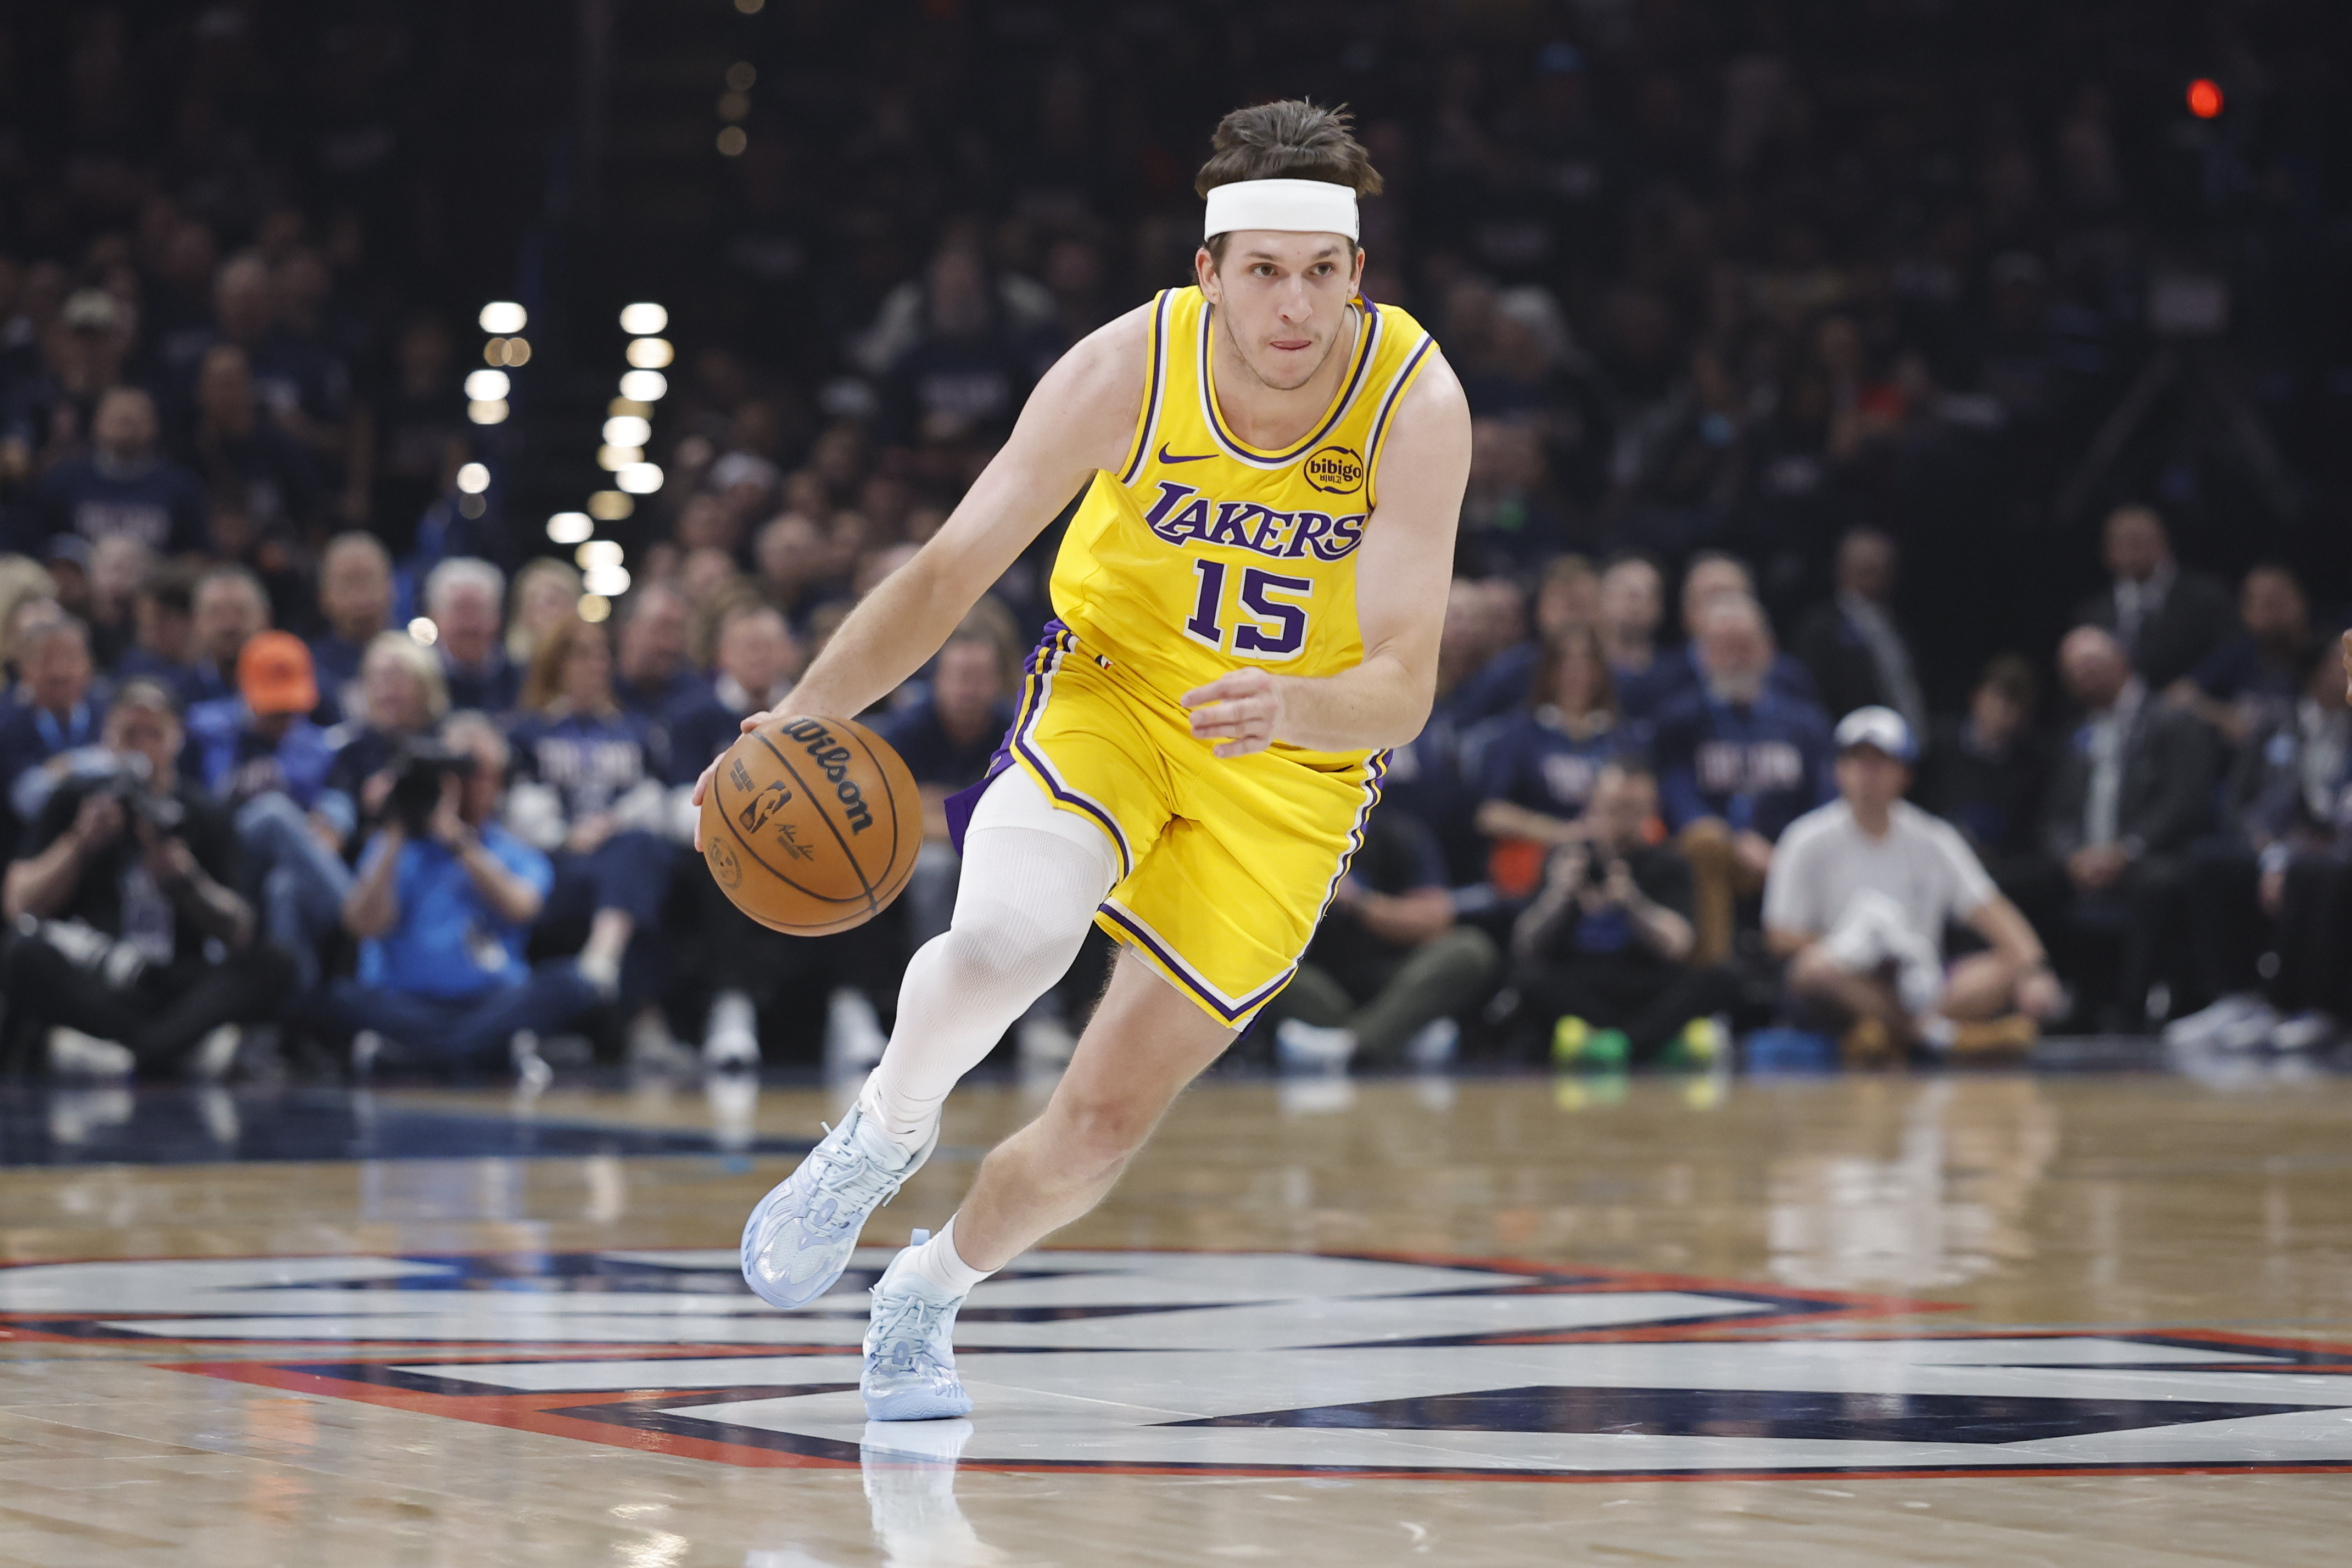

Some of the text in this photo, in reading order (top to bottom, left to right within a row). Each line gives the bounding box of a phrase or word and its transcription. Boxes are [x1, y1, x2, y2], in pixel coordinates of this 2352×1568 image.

[1310, 458, 1361, 481] bibigo
[1320, 474, 1342, 483] 비비고
[1146, 479, 1368, 562] LAKERS
[1184, 558, 1313, 660] 15
[781, 718, 873, 836] Wilson
